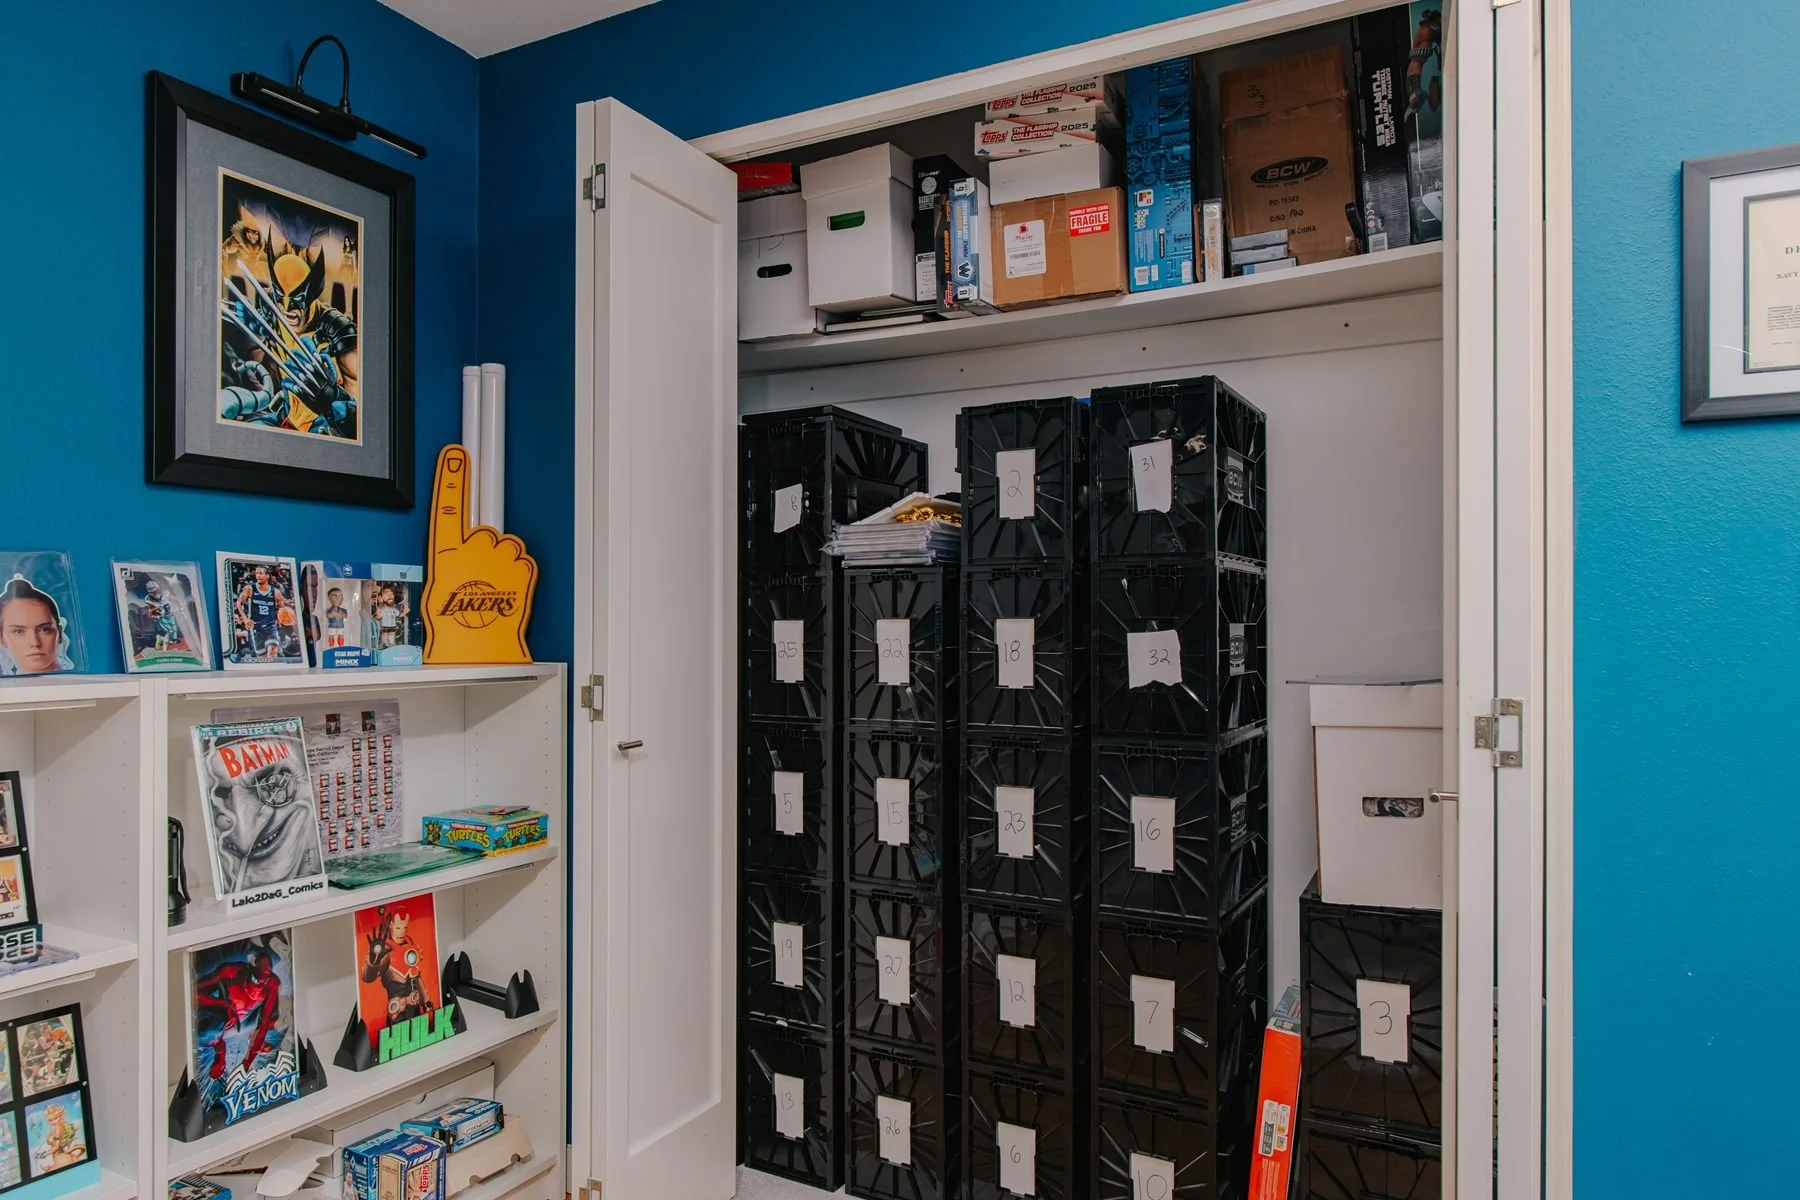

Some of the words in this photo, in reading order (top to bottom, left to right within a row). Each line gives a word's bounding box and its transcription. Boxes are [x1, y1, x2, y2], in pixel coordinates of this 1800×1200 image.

[1069, 82, 1096, 93] 2025
[1371, 70, 1386, 147] TURTLES
[1012, 131, 1054, 141] COLLECTION
[1026, 122, 1058, 132] FLAGSHIP
[1061, 122, 1089, 132] 2025
[1266, 162, 1311, 179] BCW
[1071, 212, 1108, 228] FRAGILE
[1093, 225, 1102, 233] YOU
[1297, 225, 1316, 234] CHINA
[1775, 271, 1799, 280] NAVY
[1141, 456, 1155, 472] 31
[1007, 469, 1023, 498] 2
[790, 494, 798, 512] 8
[258, 605, 270, 616] 12
[437, 591, 519, 617] LAKERS
[777, 640, 798, 659] 25
[882, 638, 905, 658] 22
[1004, 639, 1021, 664] 18
[1149, 648, 1171, 666] 32
[335, 659, 359, 667] MINIX
[216, 724, 284, 737] REBIRTH
[217, 741, 289, 779] BATMAN
[783, 792, 792, 815] 5
[886, 799, 903, 828] 15
[1003, 809, 1026, 834] 23
[445, 829, 491, 848] TURTLES
[503, 824, 541, 843] TURTLES
[1139, 816, 1161, 842] 16
[780, 938, 793, 959] 19
[884, 955, 904, 977] 27
[1008, 978, 1026, 1004] 12
[1145, 1000, 1159, 1024] 7
[1368, 1001, 1393, 1036] 3
[379, 1003, 456, 1065] HULK
[221, 1072, 299, 1124] VENOM
[780, 1090, 794, 1109] 13
[884, 1116, 901, 1136] 26
[1010, 1145, 1022, 1164] 6
[1137, 1169, 1168, 1200] 10
